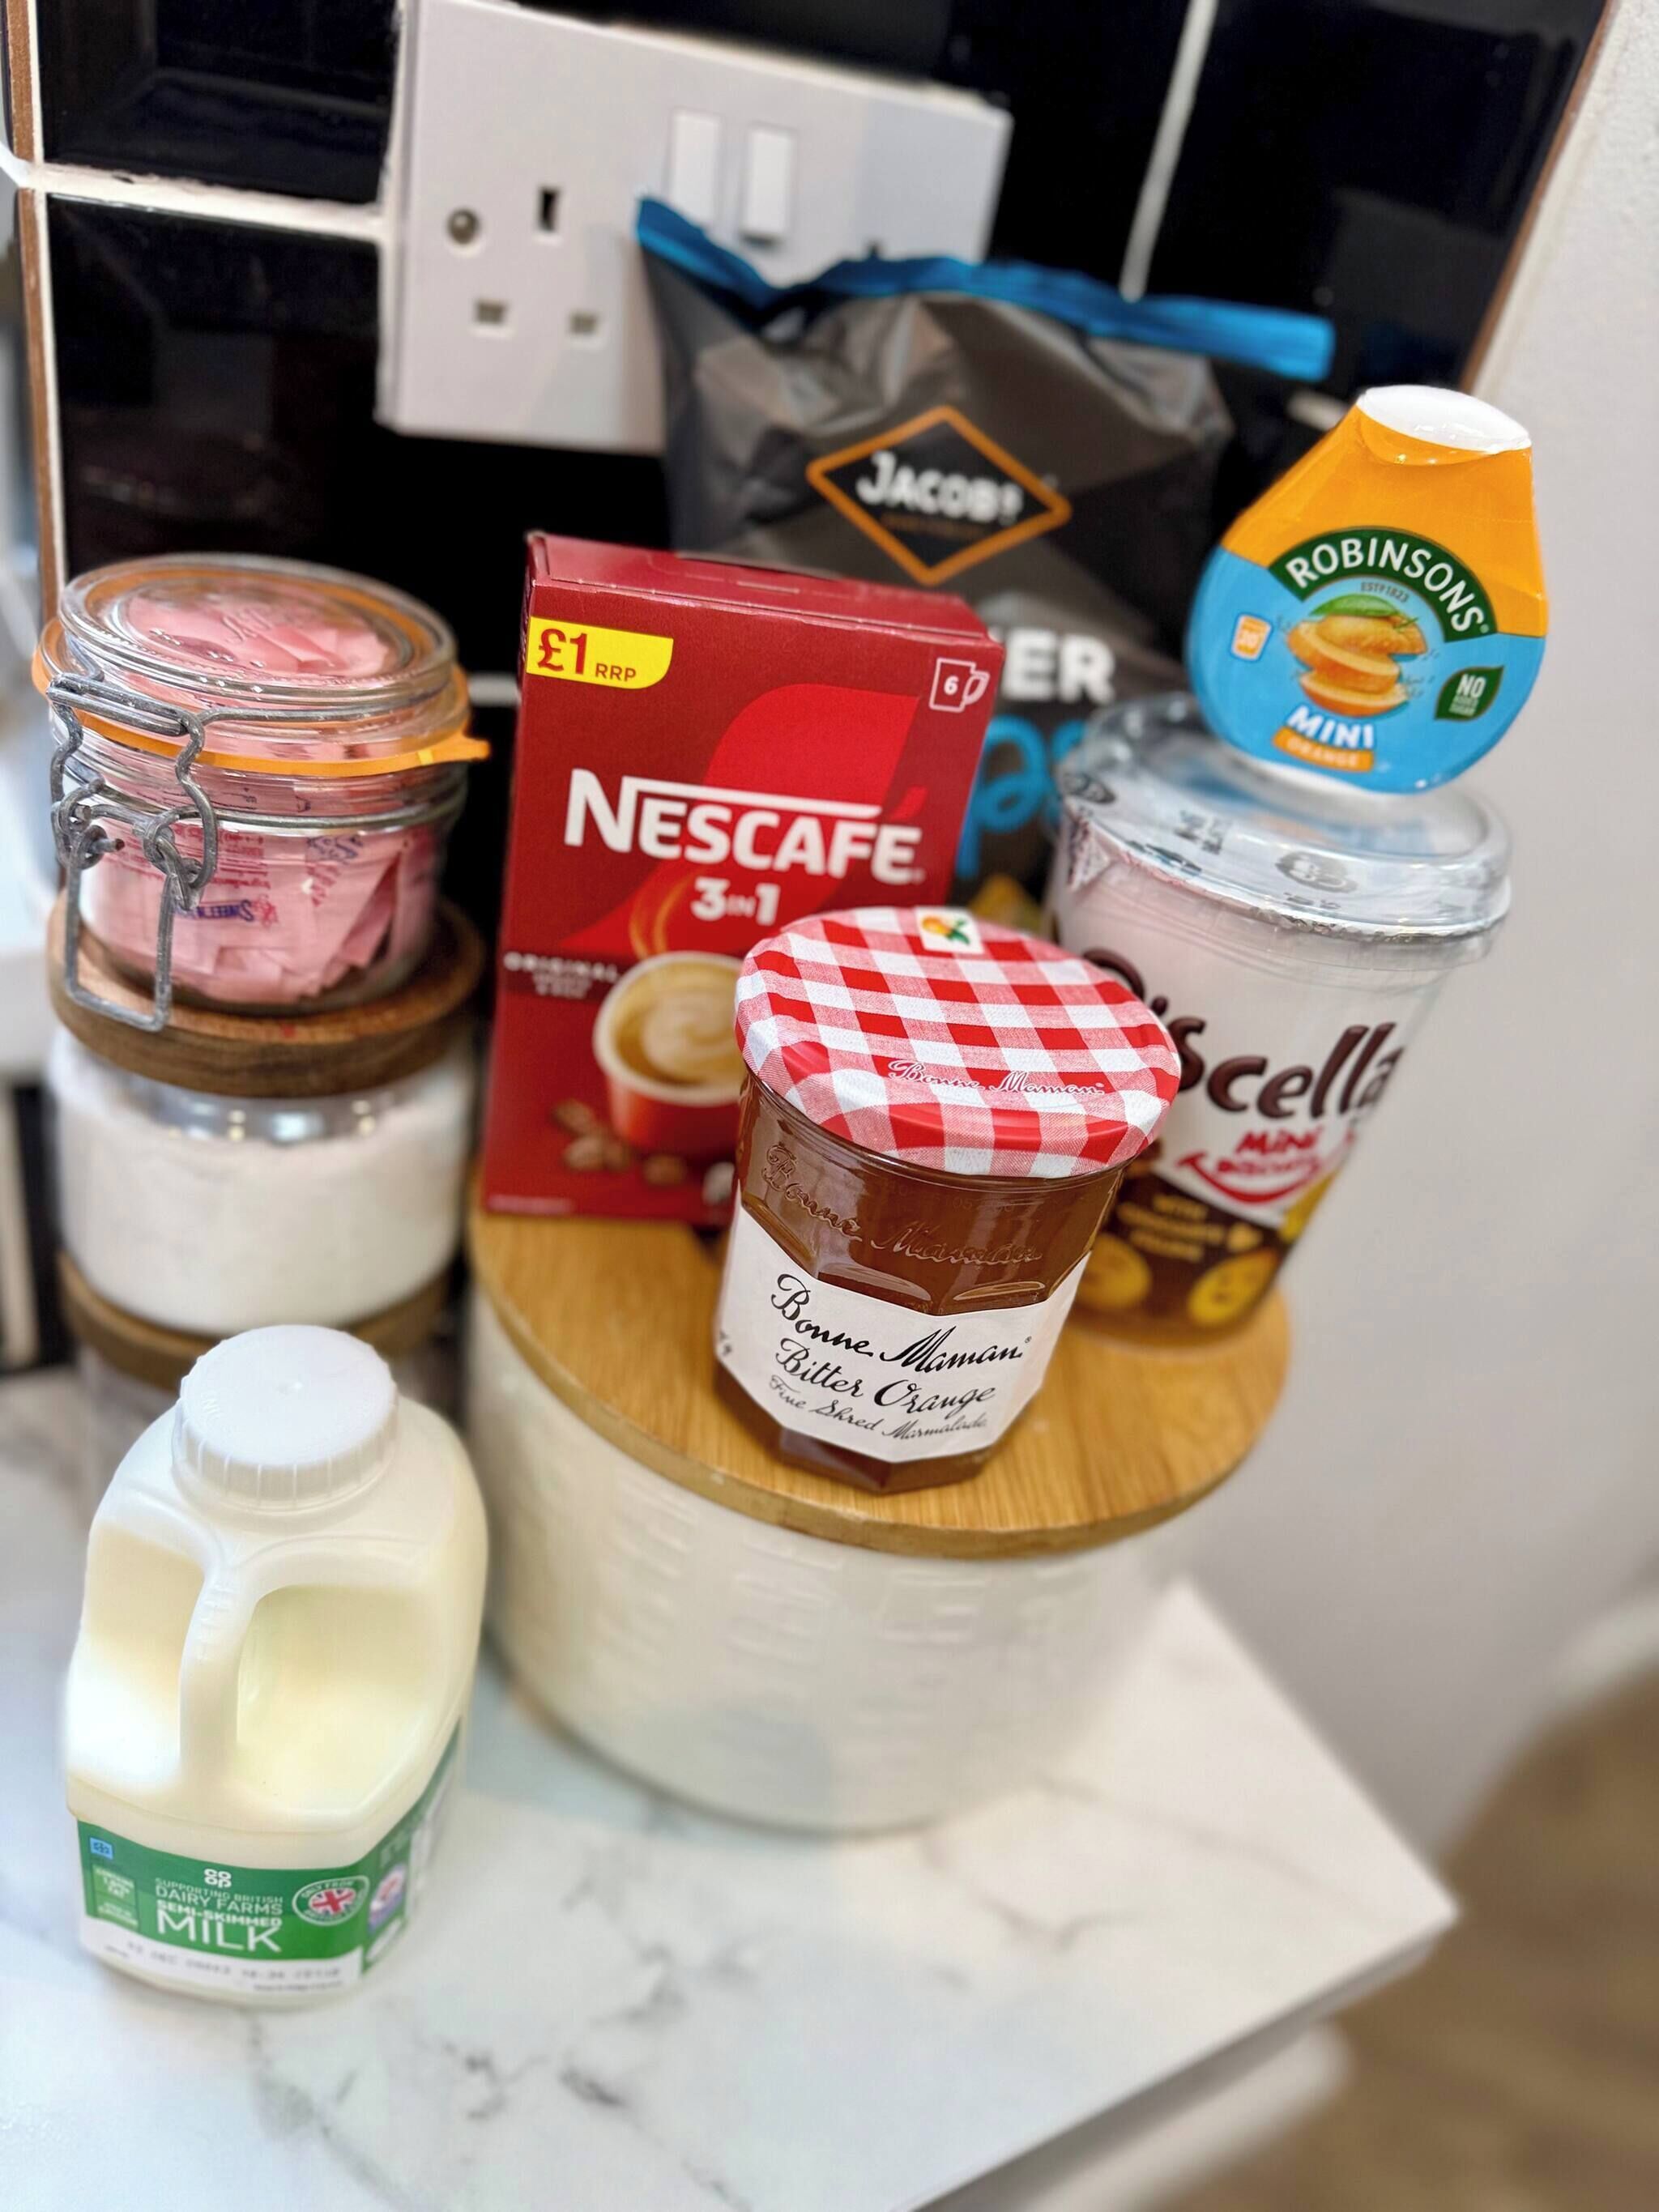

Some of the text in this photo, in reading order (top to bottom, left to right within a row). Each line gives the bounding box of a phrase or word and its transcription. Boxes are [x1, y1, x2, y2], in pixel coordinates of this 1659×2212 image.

[1286, 537, 1485, 633] ROBINSONS
[537, 628, 638, 684] £1 RRP
[943, 676, 959, 696] 6
[1456, 673, 1487, 698] NO
[1287, 705, 1375, 749] MINI
[887, 1059, 982, 1091] Bonne
[761, 1143, 862, 1242] Bonne
[770, 1272, 873, 1358] Bonne
[775, 1337, 864, 1399] Bitter
[873, 1379, 996, 1421] Orange
[769, 1375, 987, 1441] Fine Shred Marmalade
[155, 1877, 231, 1901] SUPPORTING
[233, 1893, 284, 1904] BRITISH
[156, 1884, 211, 1908] DAIRY
[215, 1898, 284, 1916] FARMS
[156, 1899, 284, 1929] SEMI-SKIMMED
[156, 1908, 282, 1953] MILK
